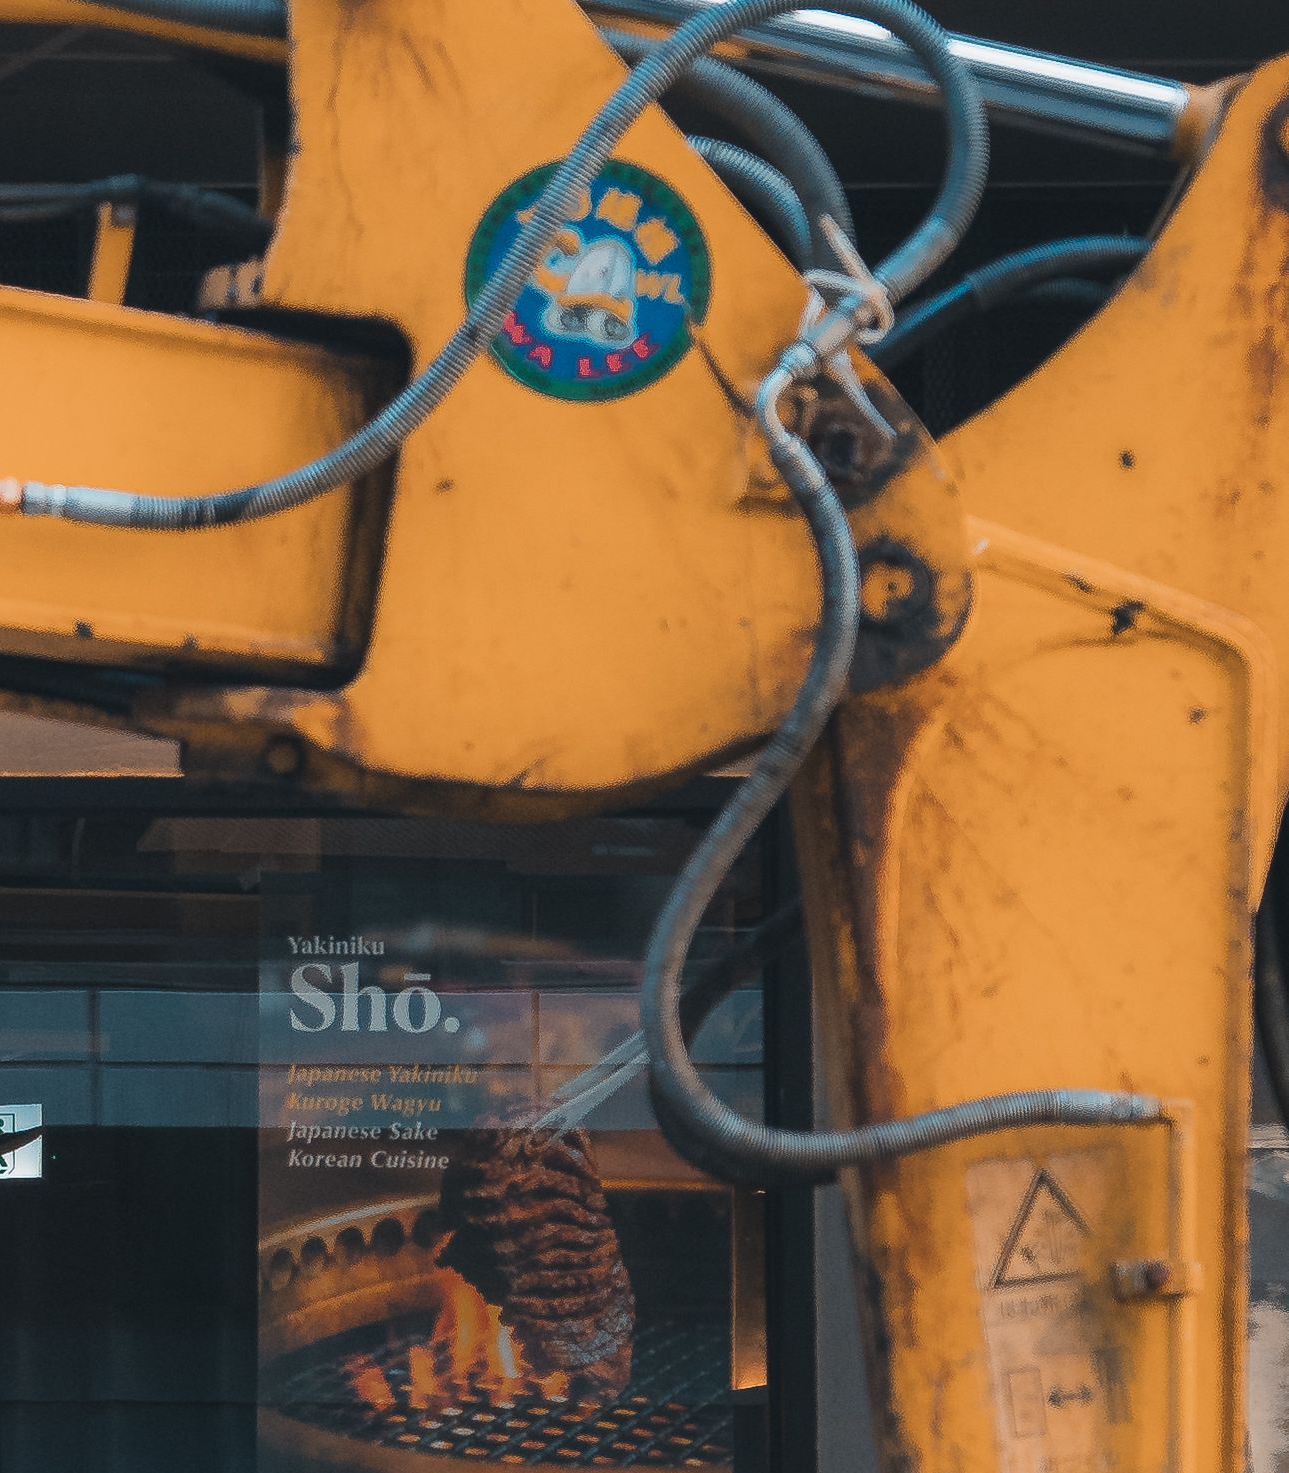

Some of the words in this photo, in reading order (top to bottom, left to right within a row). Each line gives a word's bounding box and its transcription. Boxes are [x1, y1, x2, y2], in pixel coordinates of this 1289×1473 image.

[288, 935, 385, 956] Yakiniku
[288, 961, 460, 1034] Shō.
[287, 1062, 382, 1087] Japanese
[388, 1062, 479, 1084] Yakiniku
[287, 1091, 364, 1116] Kuroge
[370, 1093, 442, 1117] Wagyu
[287, 1120, 382, 1144] Japanese
[389, 1120, 438, 1141] Sake
[287, 1148, 362, 1168] Korean
[370, 1149, 449, 1170] Cuisine
